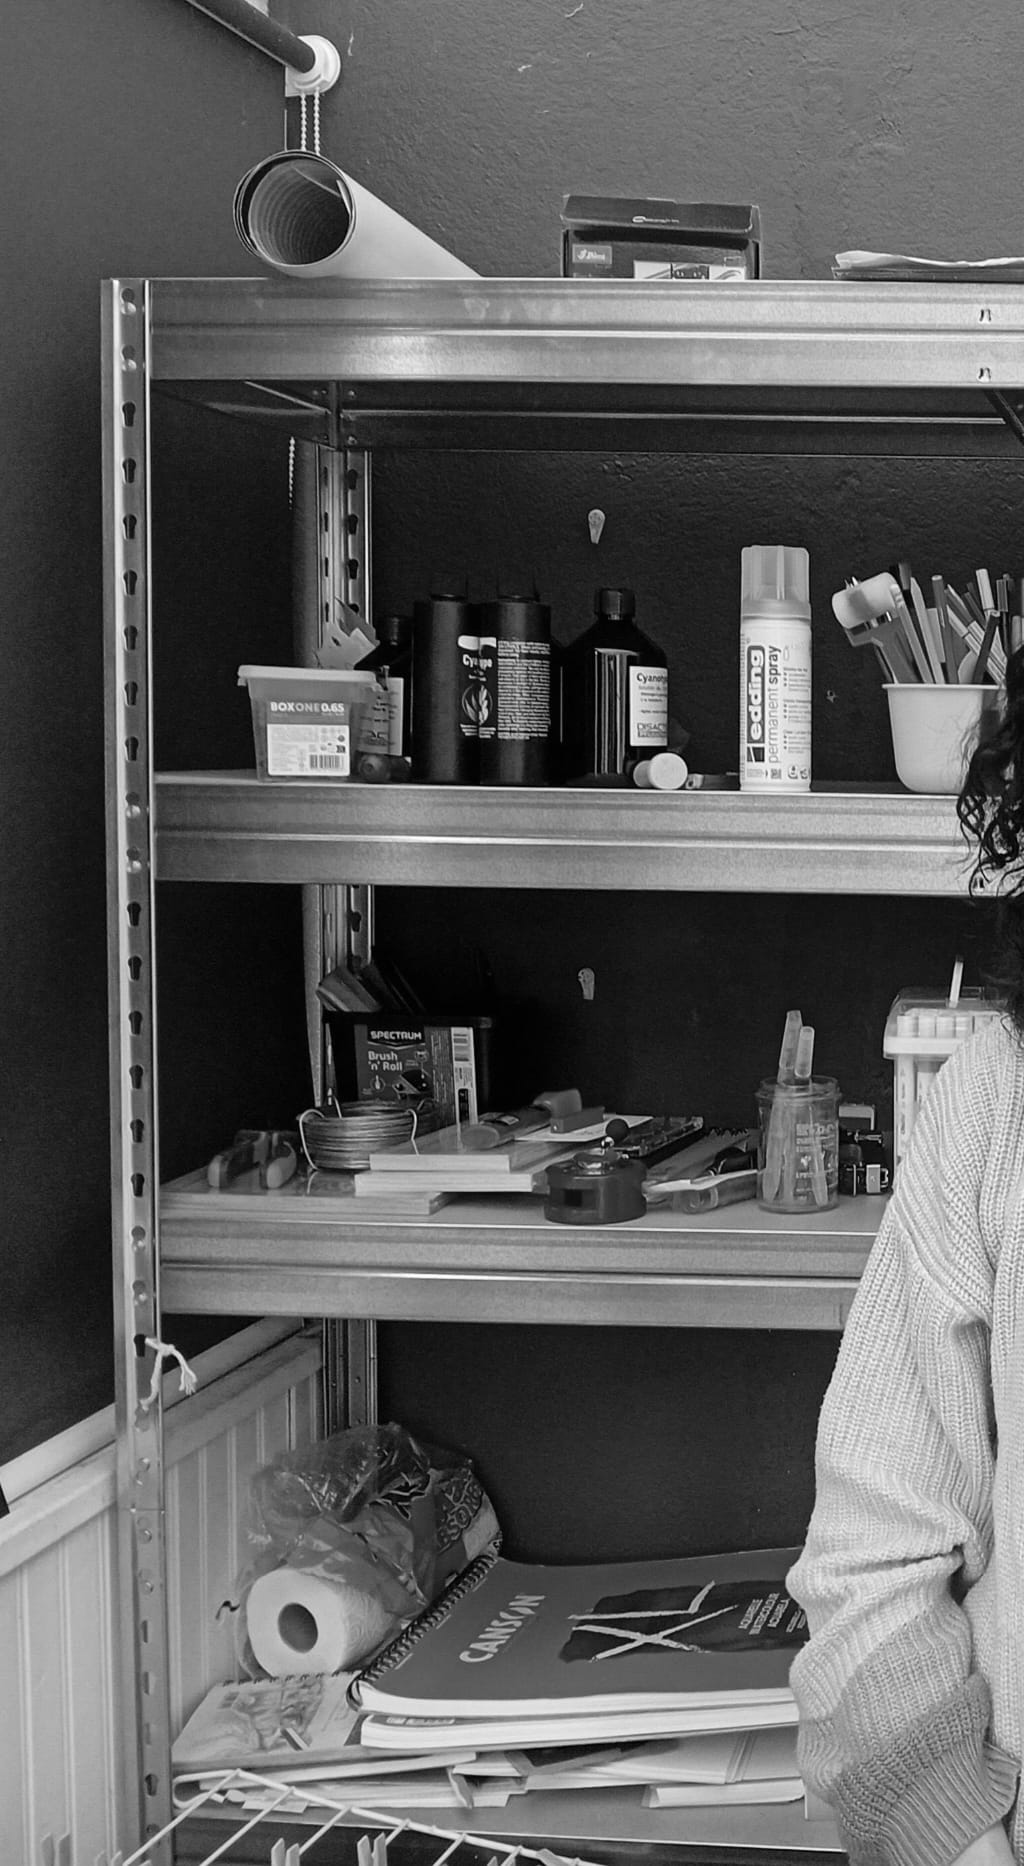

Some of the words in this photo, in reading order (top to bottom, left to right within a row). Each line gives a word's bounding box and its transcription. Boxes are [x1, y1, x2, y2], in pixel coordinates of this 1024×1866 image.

[768, 645, 782, 685] spray
[748, 648, 764, 741] edding
[768, 687, 782, 764] permanent
[370, 1030, 422, 1041] SPECTRUM
[367, 1050, 398, 1062] Brush
[382, 1061, 403, 1072] Roll
[459, 1594, 546, 1663] CANSON
